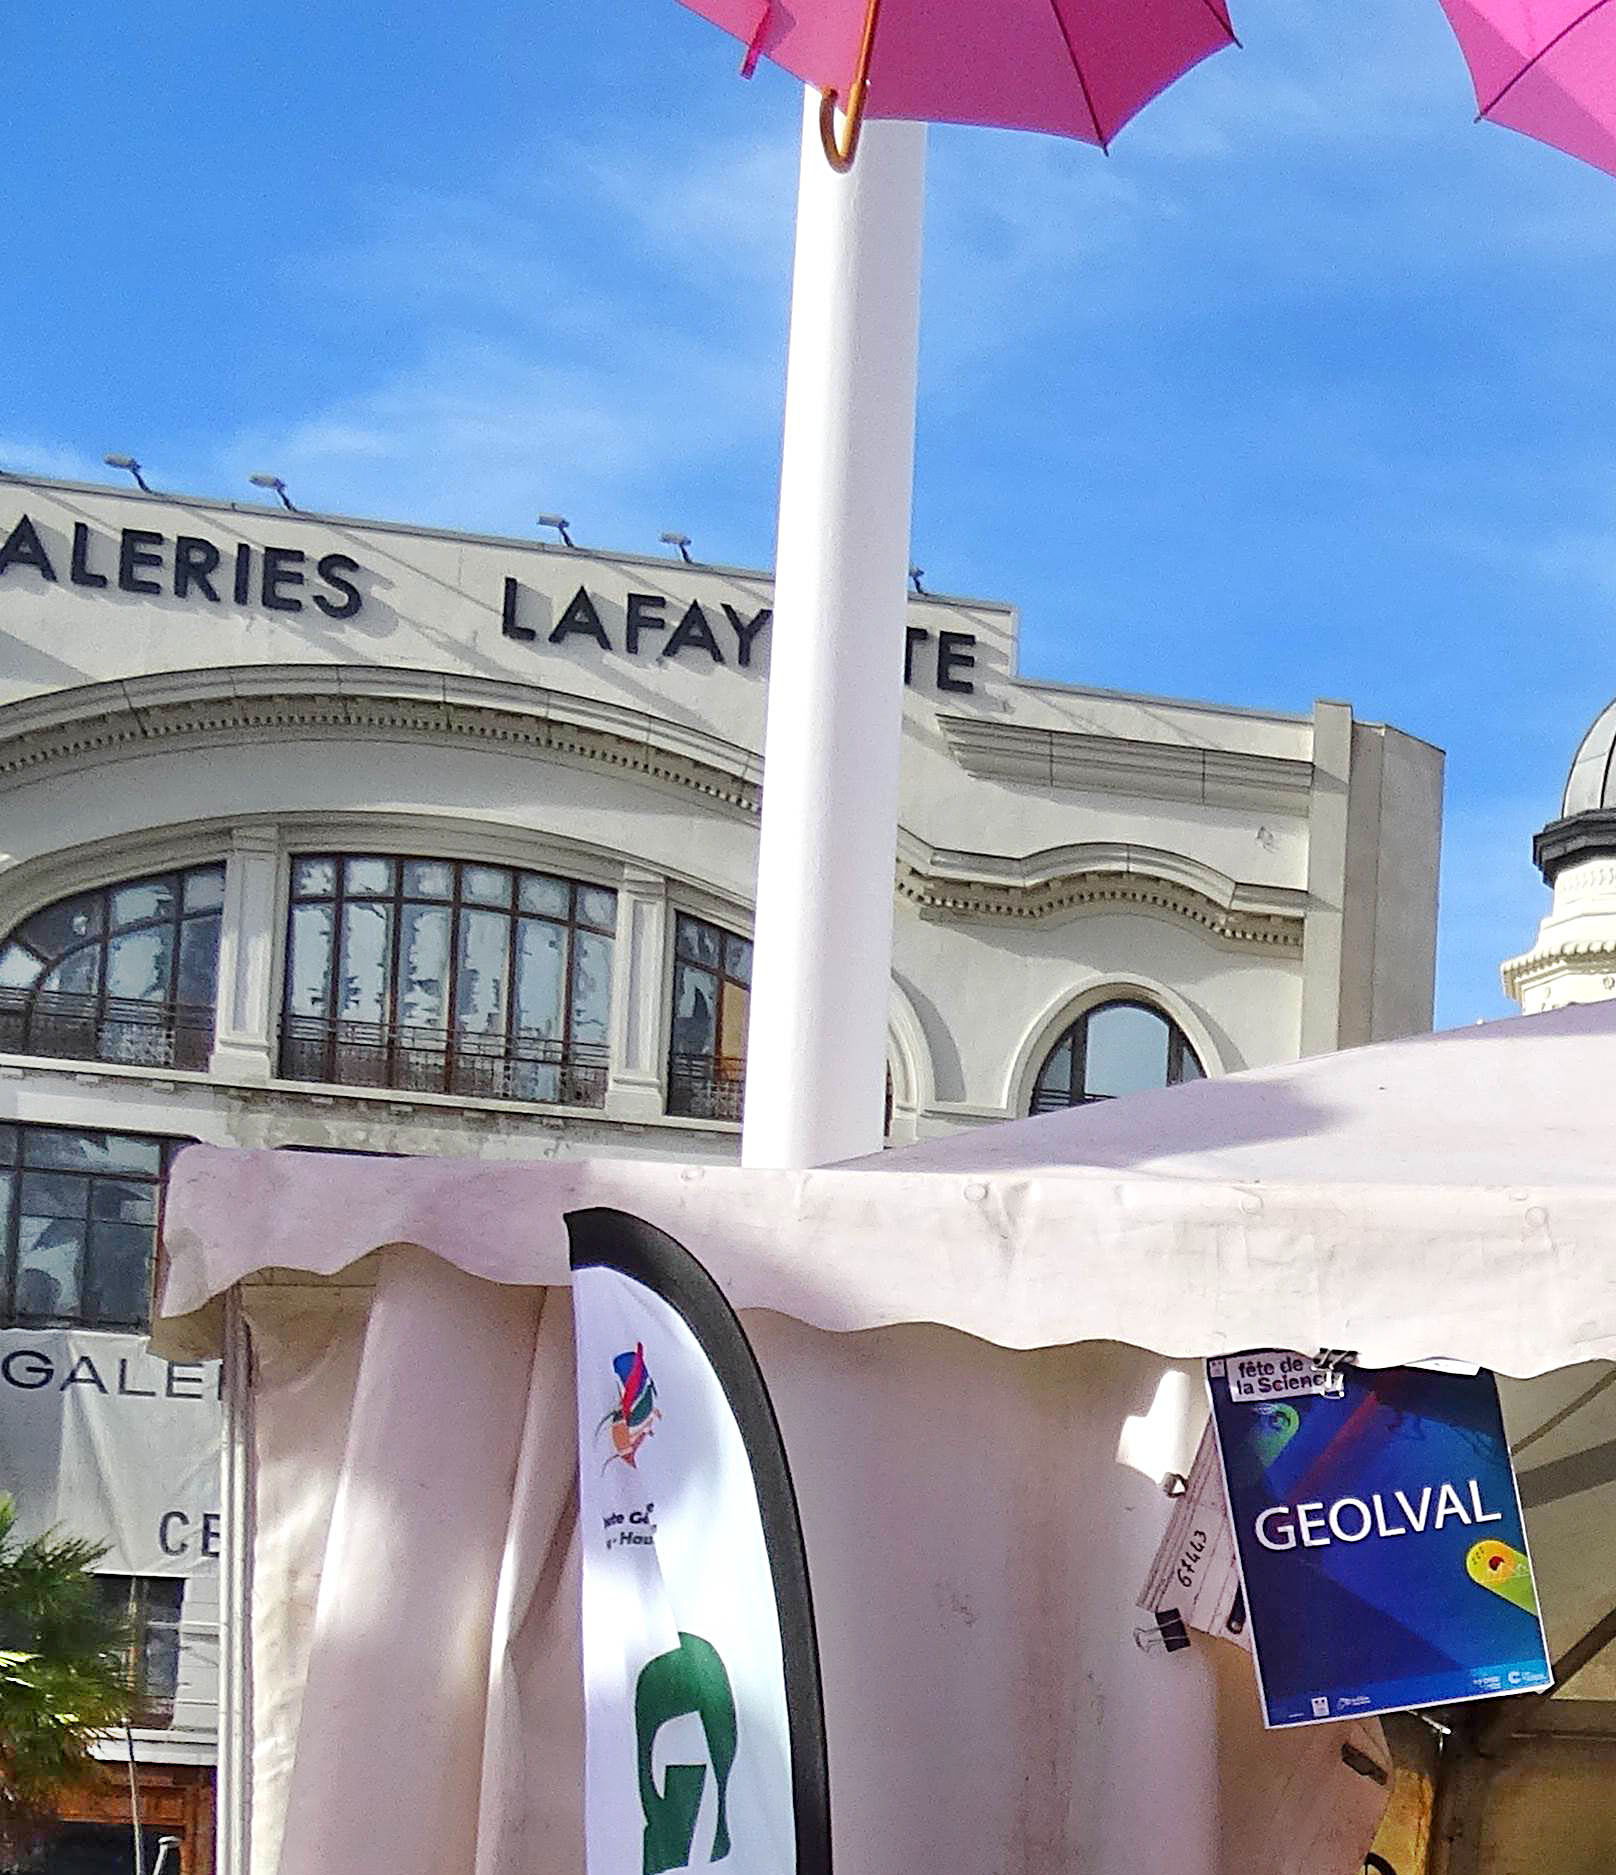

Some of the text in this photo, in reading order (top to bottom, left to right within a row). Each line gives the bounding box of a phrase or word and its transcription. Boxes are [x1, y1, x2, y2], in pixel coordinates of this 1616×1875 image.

[1239, 1356, 1304, 1378] fête de
[1236, 1379, 1254, 1395] la
[1255, 1480, 1502, 1551] GEOLVAL
